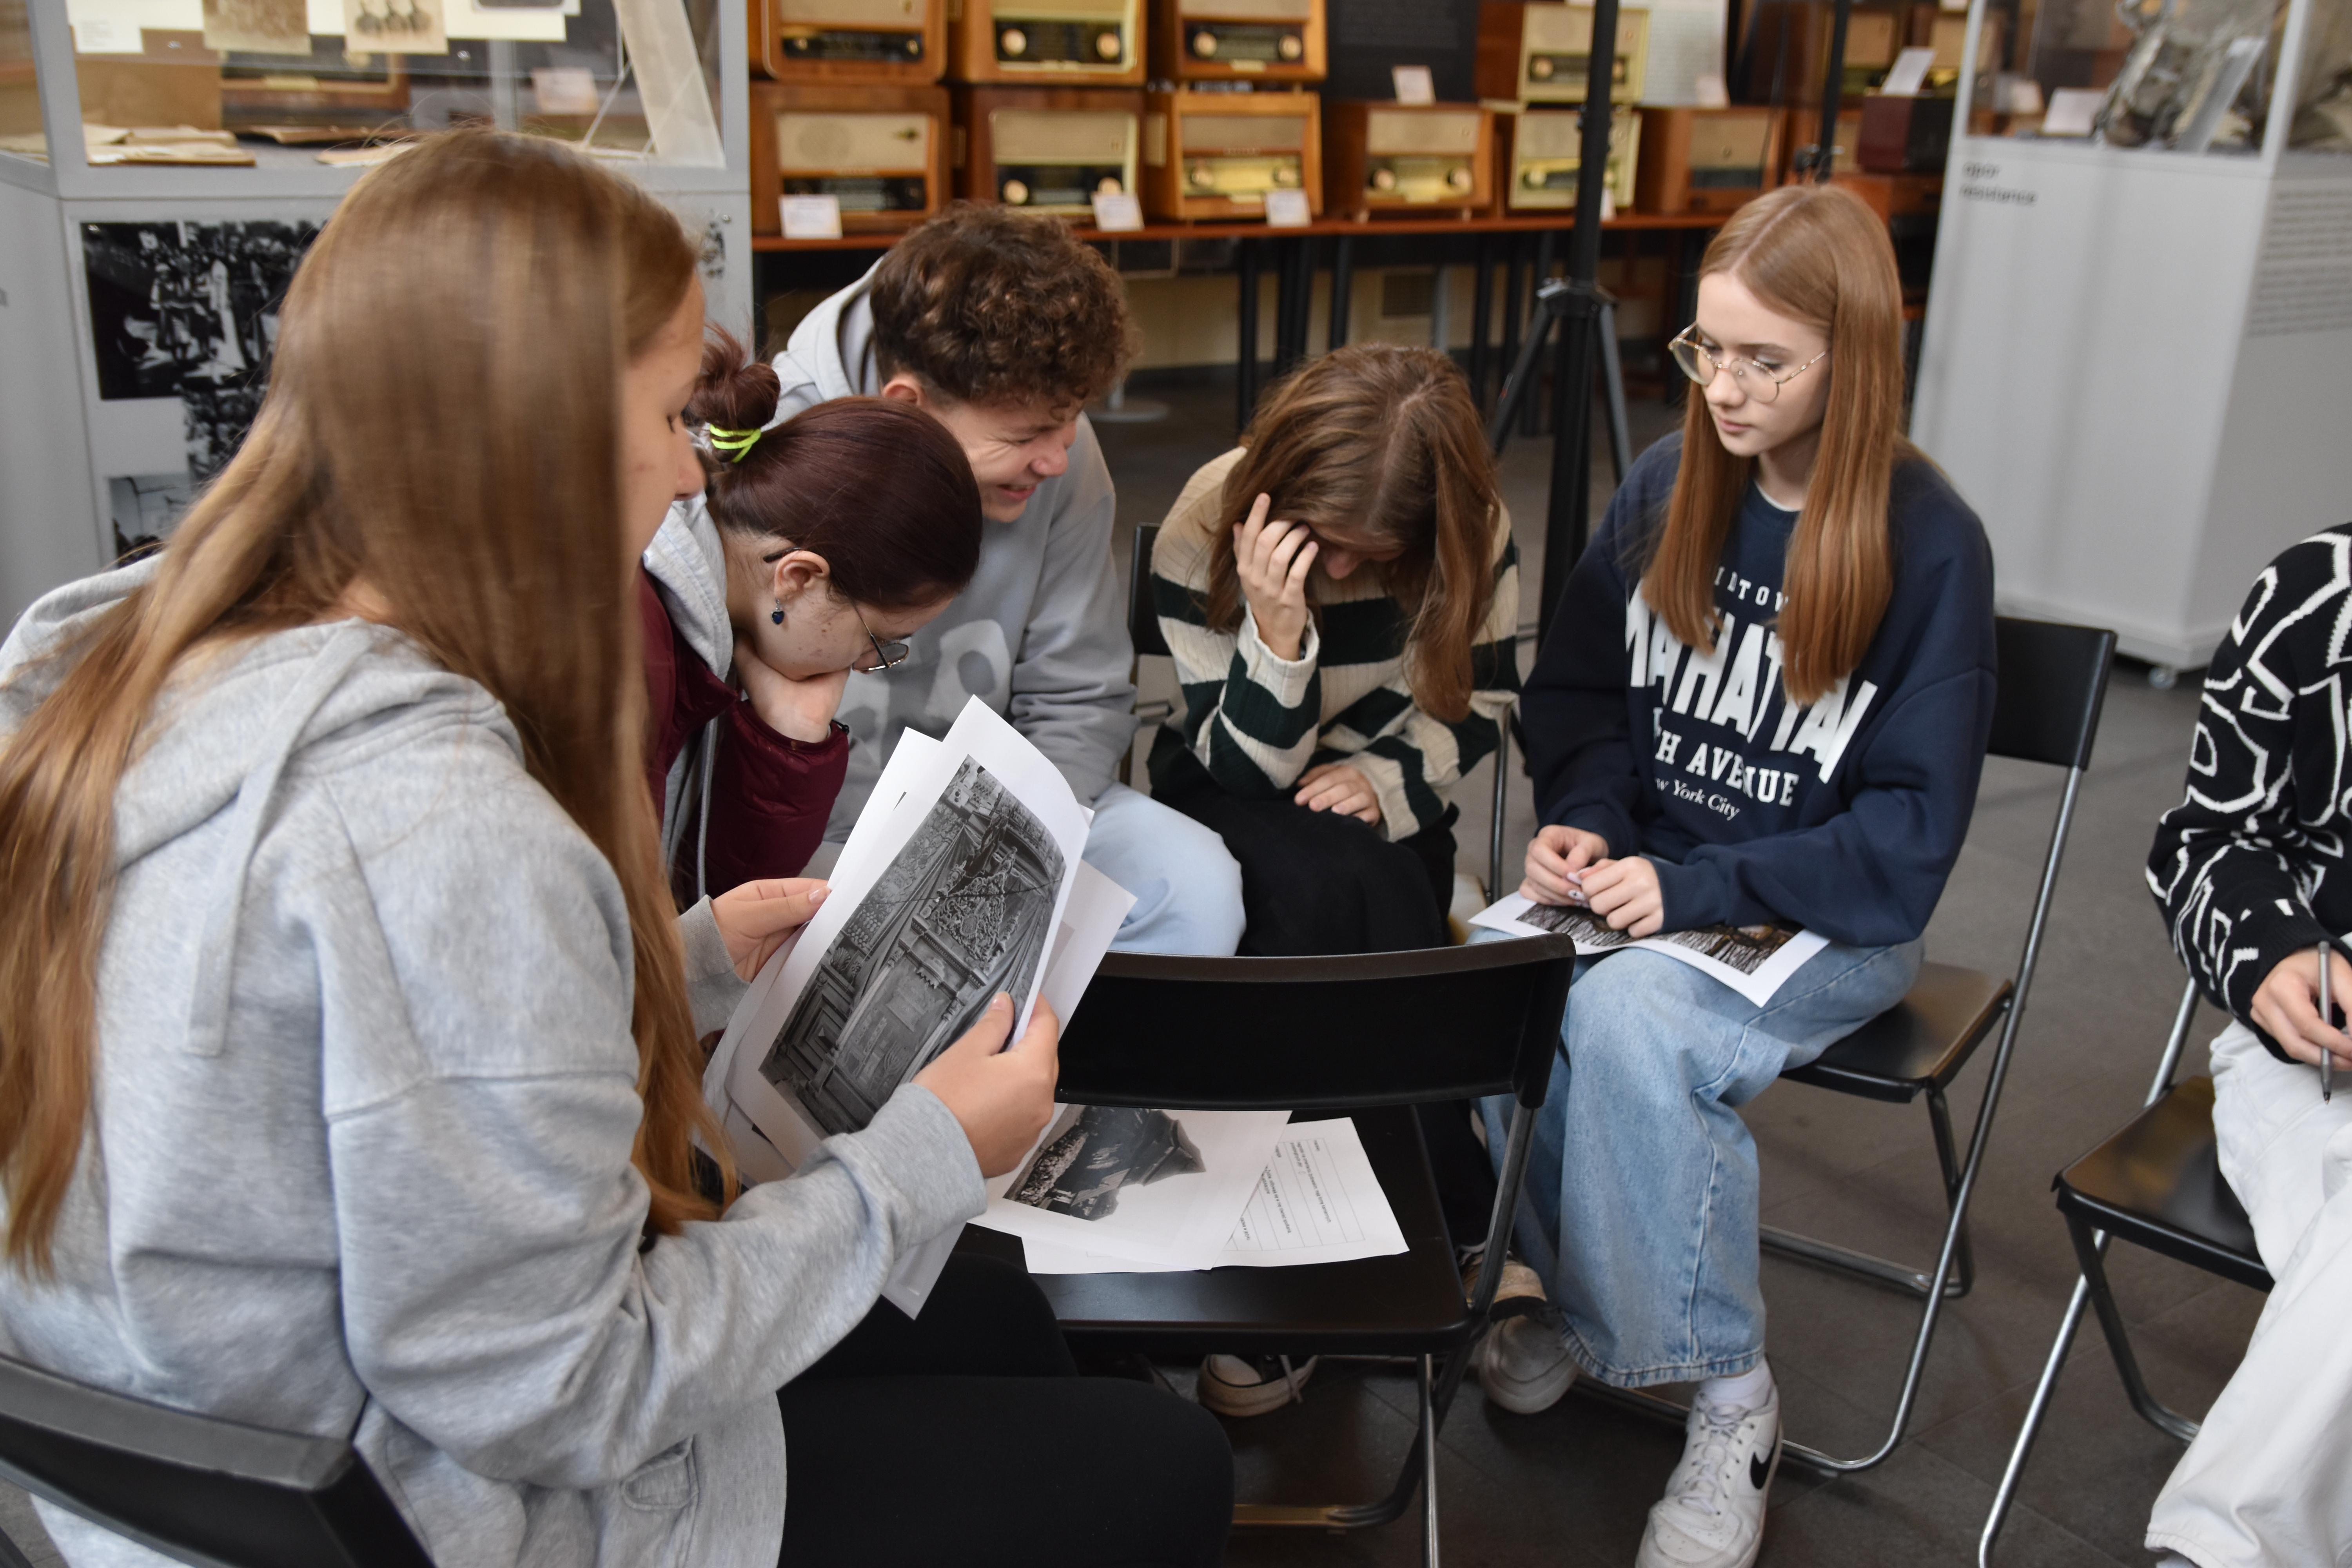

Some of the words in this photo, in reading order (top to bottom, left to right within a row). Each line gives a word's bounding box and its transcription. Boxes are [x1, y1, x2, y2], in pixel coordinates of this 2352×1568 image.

[1673, 779, 1706, 804] York
[1708, 794, 1740, 821] City
[1686, 742, 1799, 807] AVENUE
